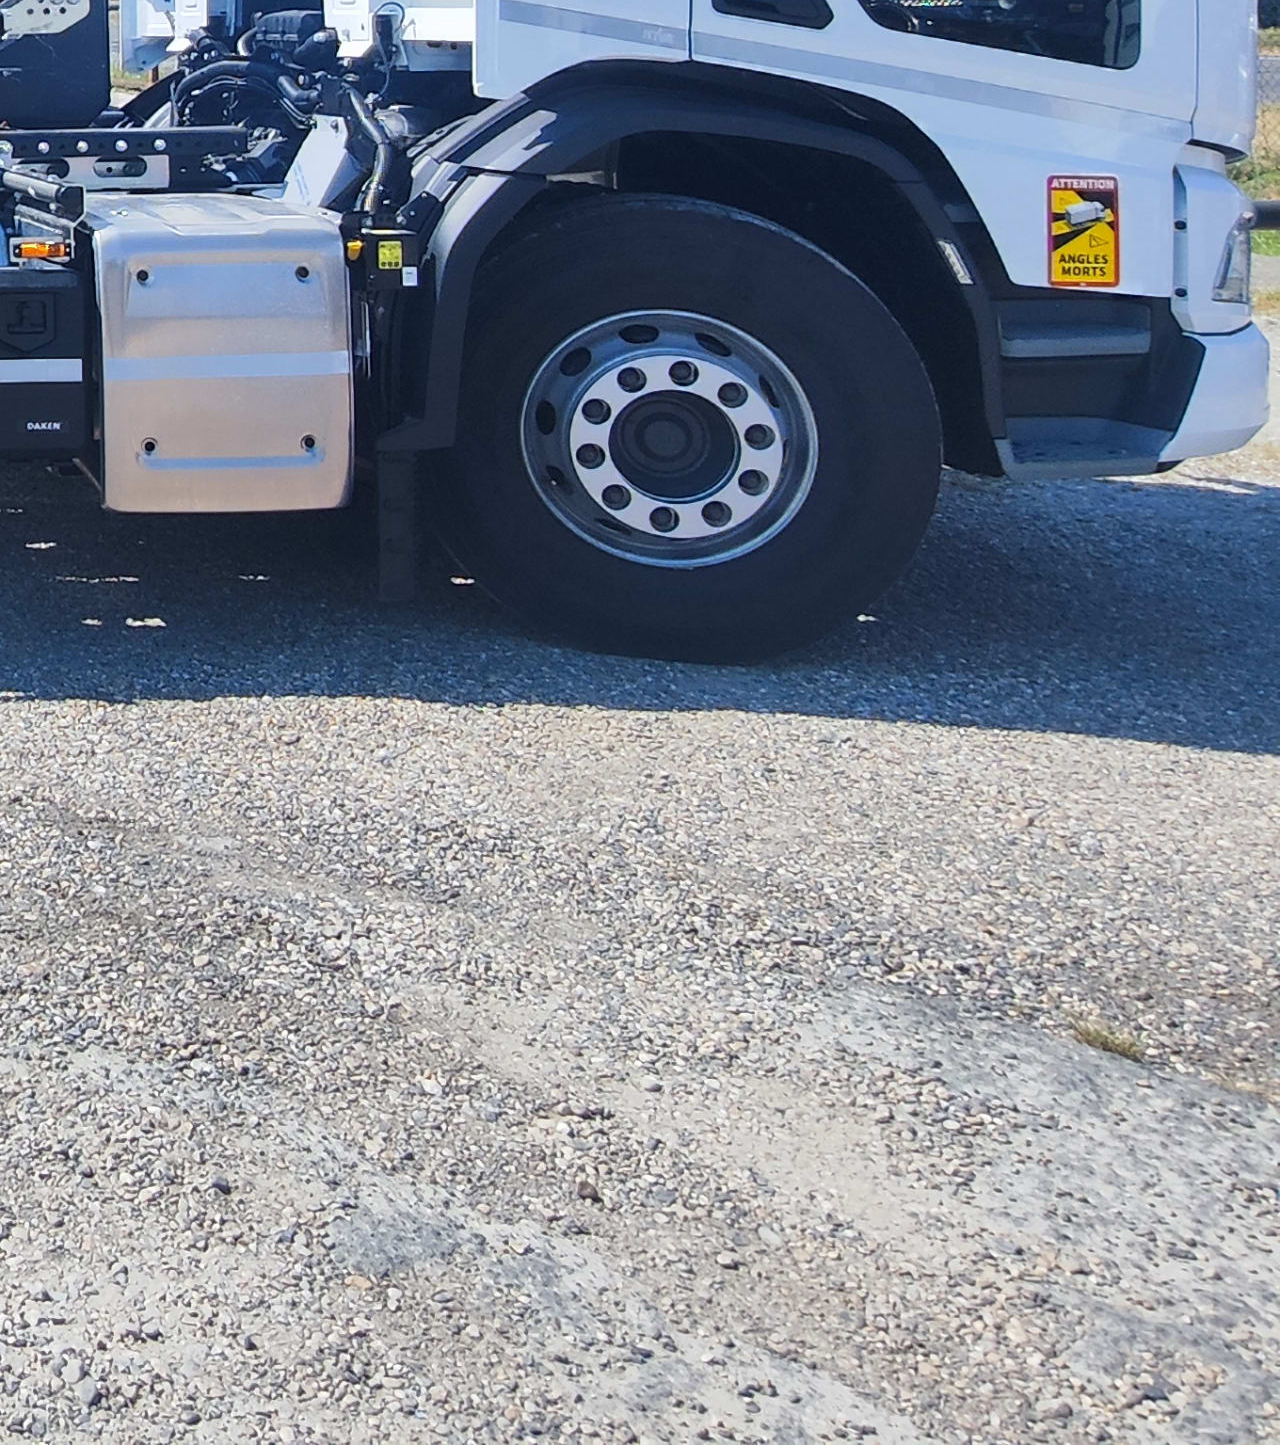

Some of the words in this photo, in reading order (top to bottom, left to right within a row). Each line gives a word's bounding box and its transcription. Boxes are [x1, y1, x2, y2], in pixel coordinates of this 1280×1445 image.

[1051, 178, 1114, 189] ATTENTION
[1059, 253, 1110, 265] ANGLES
[1061, 265, 1108, 277] MORTS
